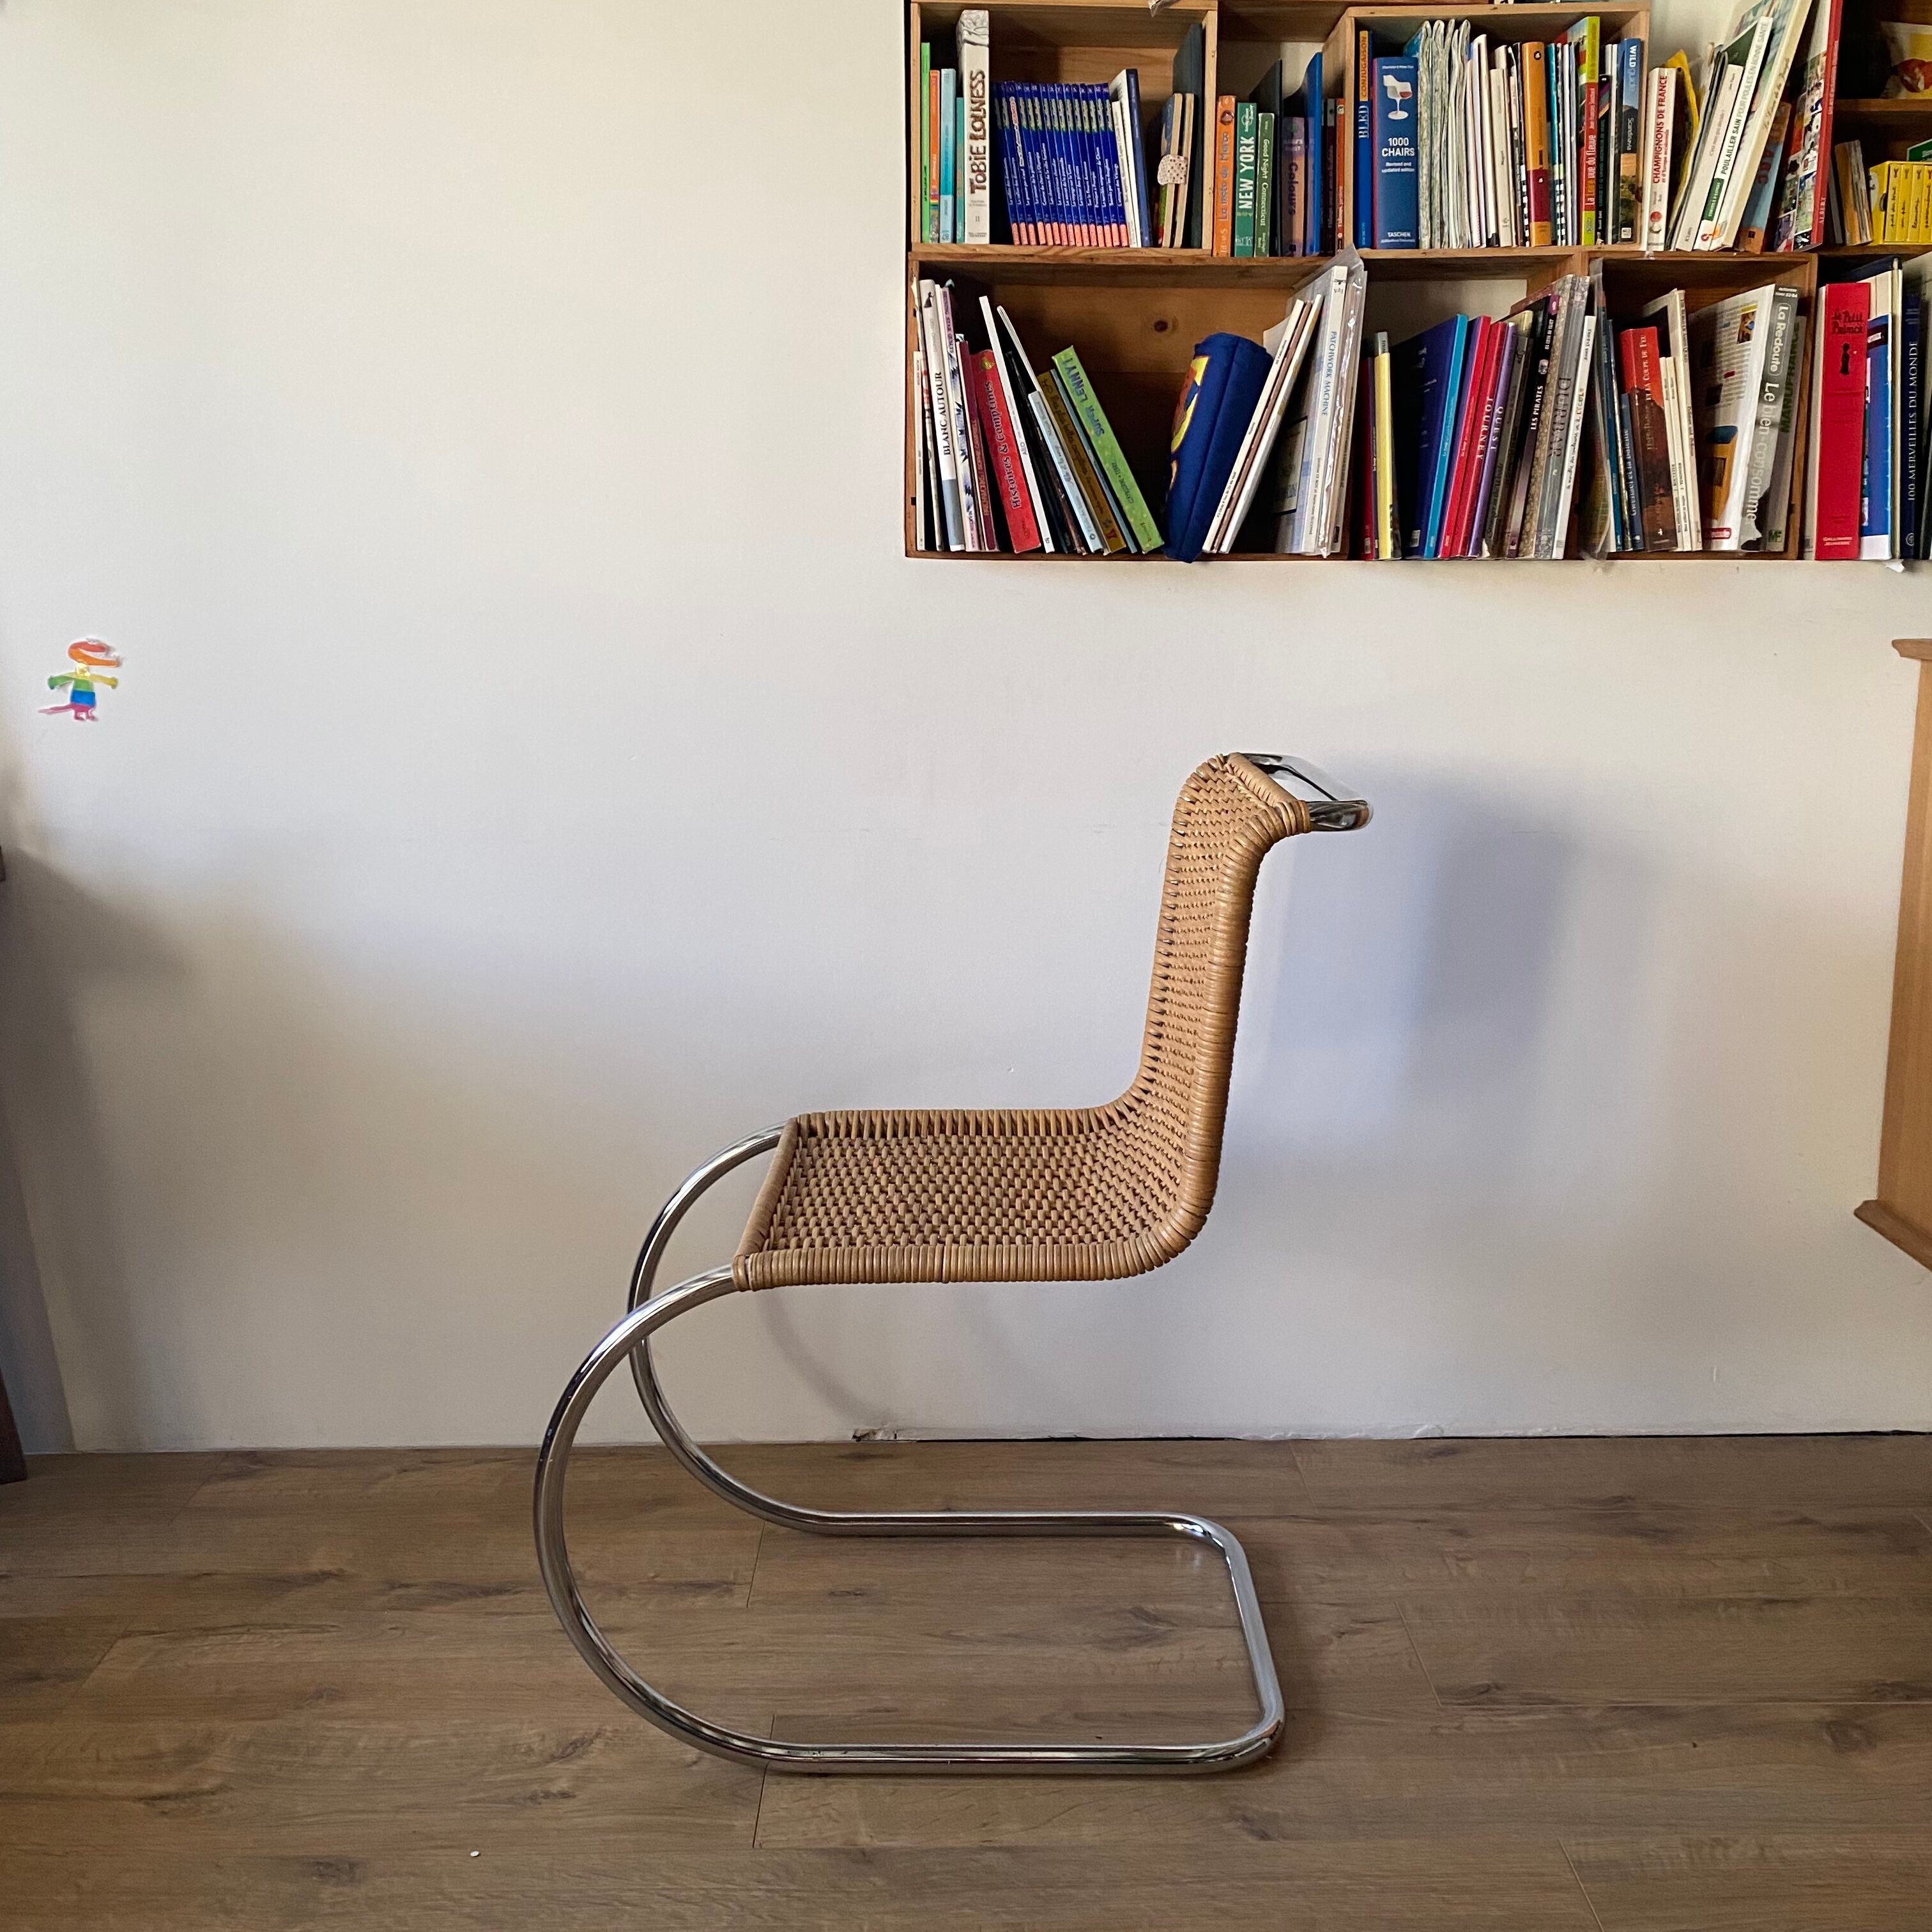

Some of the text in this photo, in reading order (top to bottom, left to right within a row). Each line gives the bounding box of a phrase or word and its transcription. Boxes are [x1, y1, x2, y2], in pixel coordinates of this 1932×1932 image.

[1747, 65, 1756, 75] EN
[1740, 75, 1754, 100] POULES
[969, 70, 986, 141] LOLNESS
[1736, 100, 1747, 118] POUR
[1358, 106, 1369, 139] BLED
[1625, 117, 1634, 150] Scandinavia
[1652, 75, 1667, 183] CHAMPIGNONS DE FRANCE
[1731, 118, 1742, 134] SAIN
[1388, 137, 1409, 146] 1000
[1585, 134, 1597, 155] fleuve
[1720, 135, 1737, 174] POULAILLER
[1239, 136, 1254, 208] NEW YORK
[1586, 157, 1596, 165] du
[1587, 166, 1595, 178] vue
[1260, 182, 1269, 226] Connecticut
[1288, 162, 1299, 215] Colours
[1817, 196, 1827, 224] ALBERT
[1770, 305, 1788, 372] La Redoute
[1832, 321, 1863, 334] Prince
[1641, 349, 1648, 358] DE
[1908, 341, 1917, 387] MONDE
[1321, 331, 1337, 416] PATCHWORK MACHINE
[1533, 385, 1544, 416] PIRATES
[1763, 381, 1779, 402] Le
[1909, 390, 1917, 408] DU
[935, 371, 951, 456] BLANC AUTOUR
[986, 381, 1005, 442] Comptines
[1475, 395, 1494, 460] JOURNEY
[1549, 377, 1571, 457] DURBAR
[1489, 405, 1505, 452] QUEST
[998, 443, 1008, 454] &
[1908, 412, 1917, 479] MERVEILLES
[1002, 456, 1022, 509] Histoires
